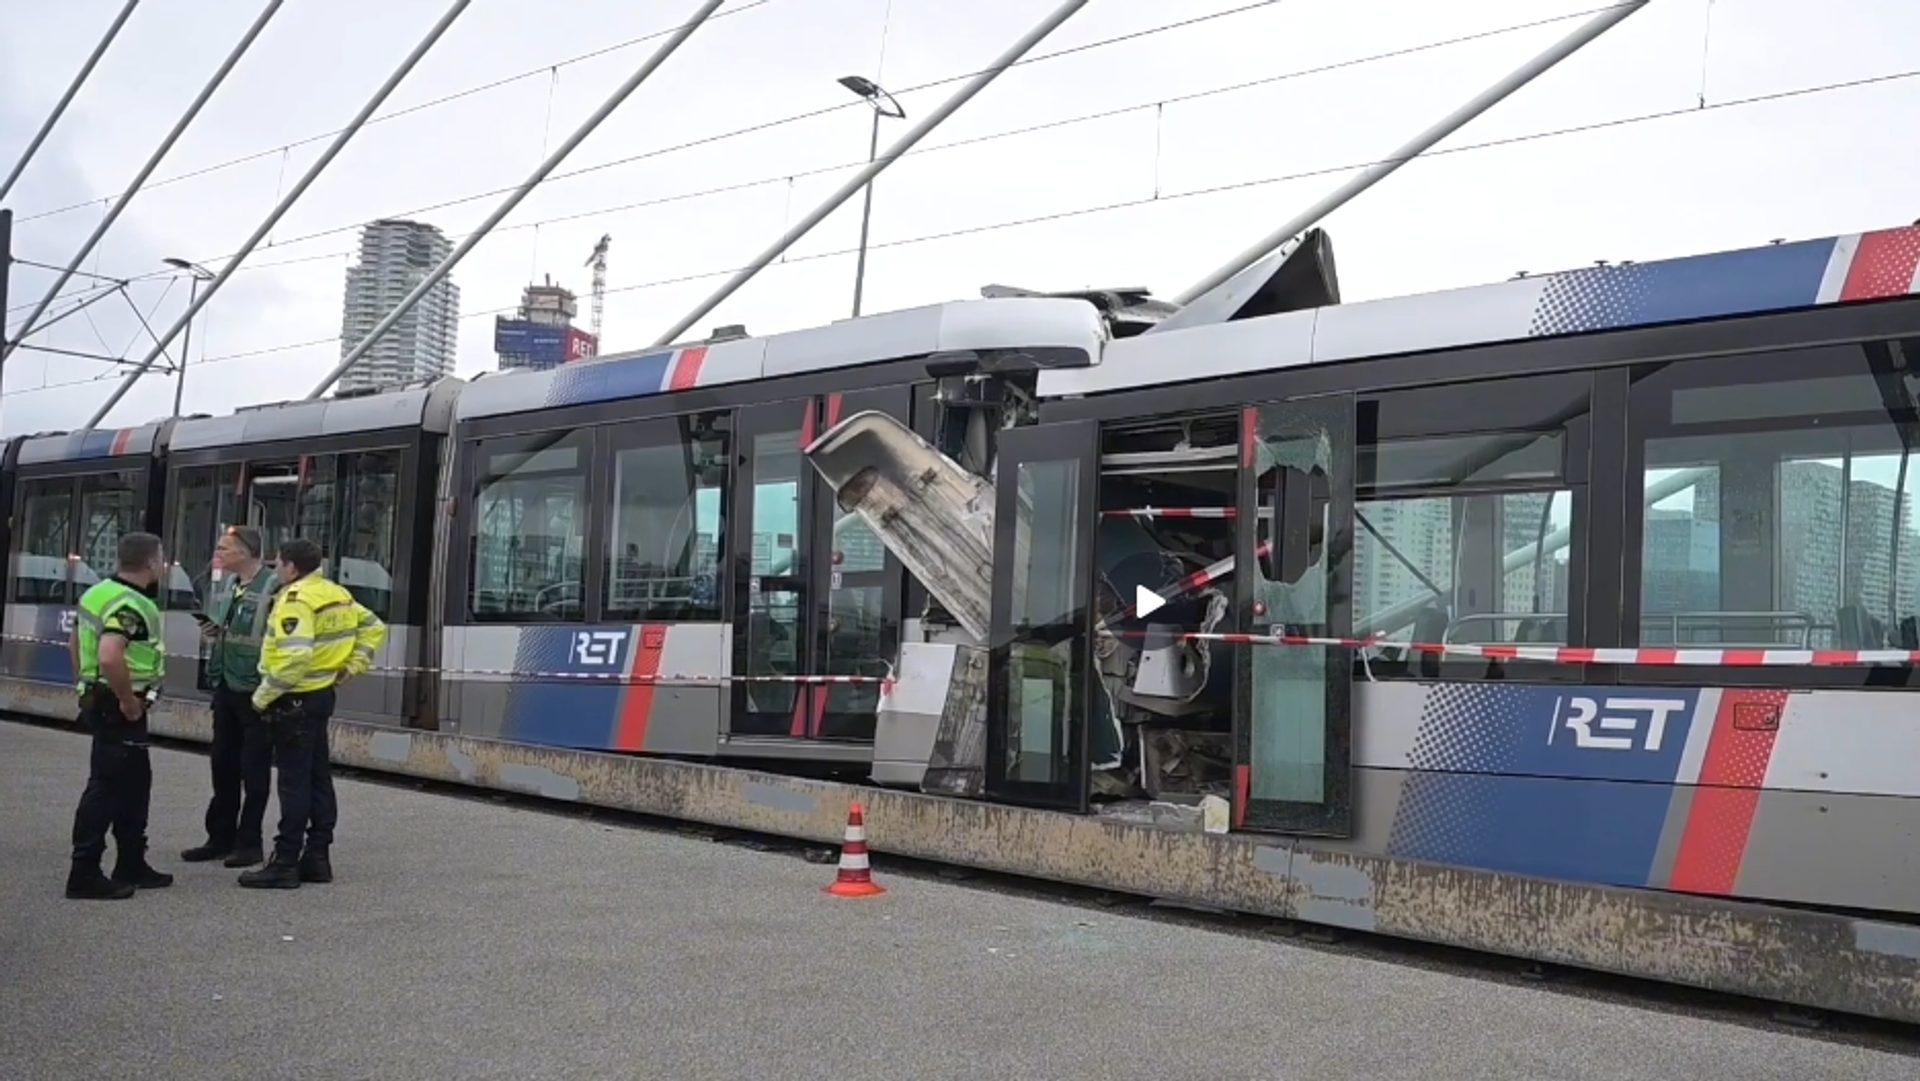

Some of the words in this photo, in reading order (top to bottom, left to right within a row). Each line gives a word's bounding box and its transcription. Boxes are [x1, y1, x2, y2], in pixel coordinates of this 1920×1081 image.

[58, 610, 77, 633] RE
[568, 631, 627, 665] RET
[1547, 696, 1686, 752] RET
